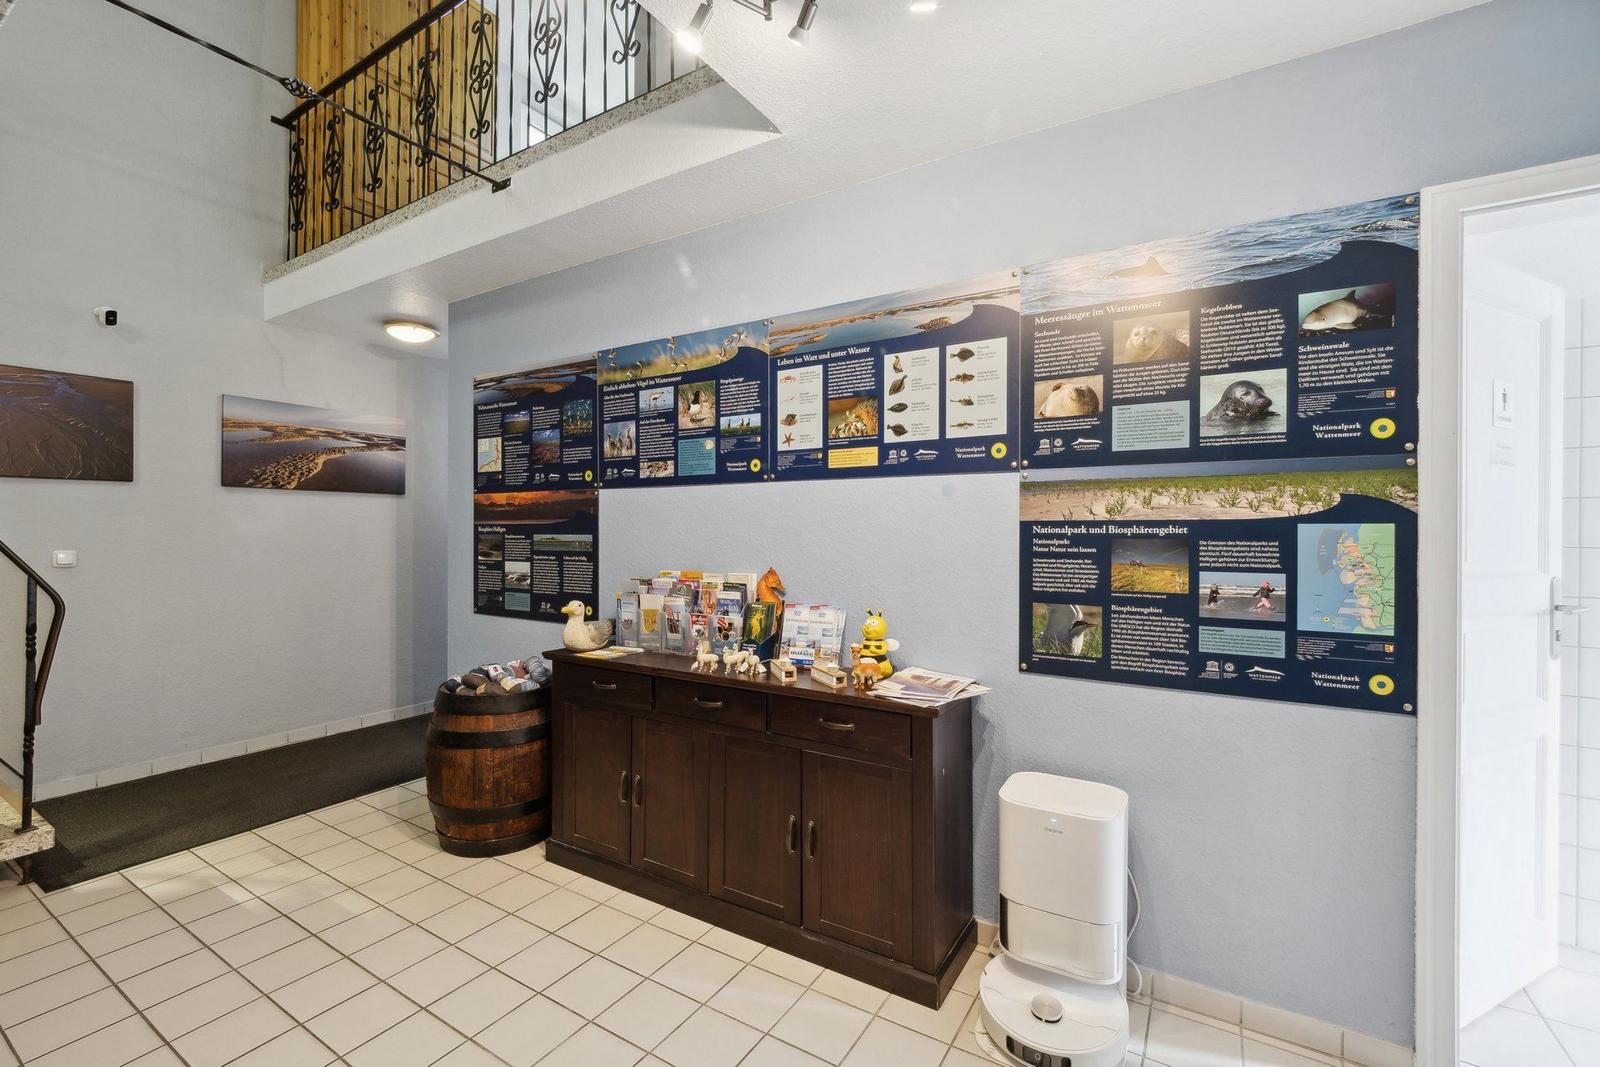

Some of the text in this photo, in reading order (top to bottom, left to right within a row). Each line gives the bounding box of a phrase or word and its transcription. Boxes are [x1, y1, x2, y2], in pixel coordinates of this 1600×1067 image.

[1034, 301, 1162, 326] Meeressäuger im Wattenmeer
[1200, 303, 1243, 314] Kegelrobben
[1298, 341, 1350, 352] Schweinswale
[777, 358, 794, 366] Leben
[803, 354, 817, 363] Watt
[818, 352, 830, 361] und
[831, 351, 847, 360] unter
[847, 346, 870, 357] Wasser
[1312, 422, 1361, 432] Nationalpark
[1315, 431, 1361, 440] Wattenmeer
[954, 445, 986, 455] Nationalpark
[957, 452, 986, 460] Wattenmeer
[1032, 525, 1188, 536] Nationalpark und Biosphärengebiet
[1111, 605, 1163, 614] Biosphärengebiet
[1312, 672, 1360, 682] Nationalpark
[1314, 680, 1360, 690] Wattenmeer
